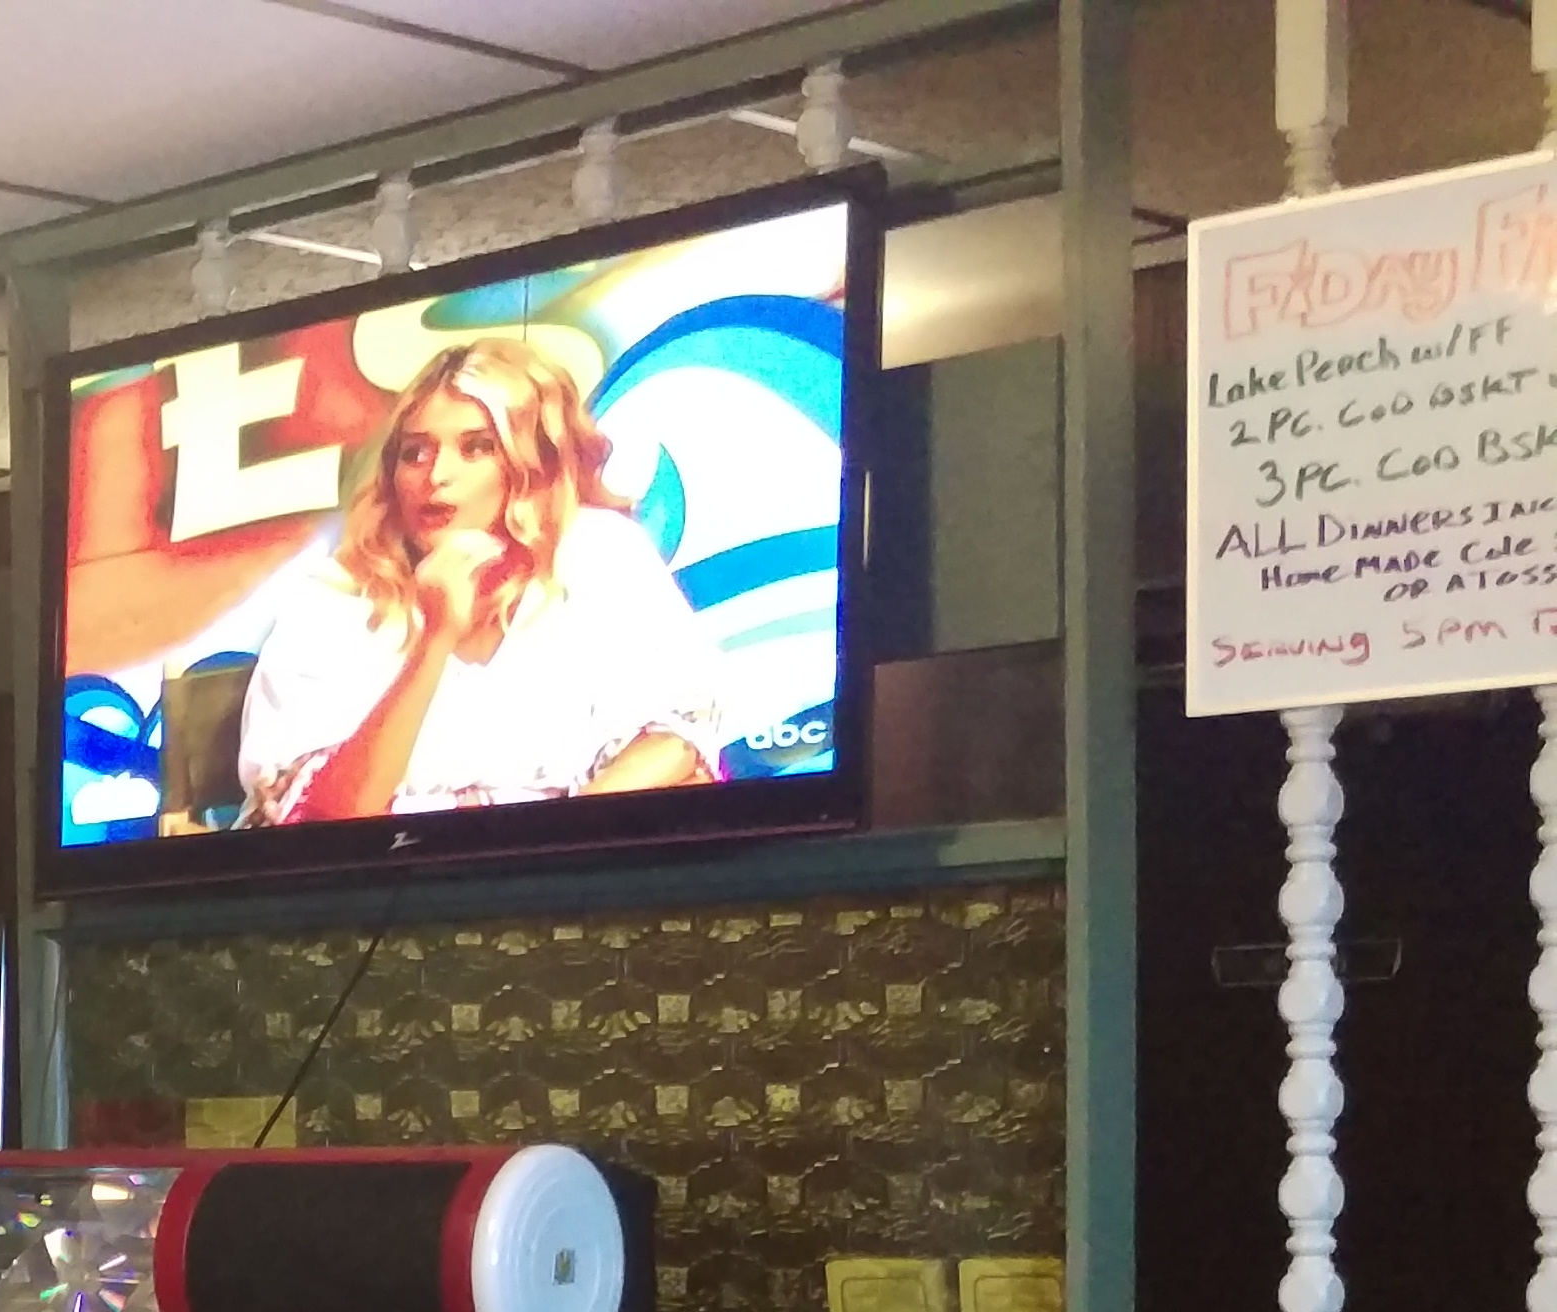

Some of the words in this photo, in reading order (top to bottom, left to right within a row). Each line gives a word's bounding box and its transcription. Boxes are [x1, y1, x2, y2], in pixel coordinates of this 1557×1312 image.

[1229, 420, 1261, 447] 2
[1256, 459, 1287, 509] 3
[1215, 516, 1306, 560] ALL
[1401, 619, 1427, 650] 5
[745, 714, 828, 750] abc
